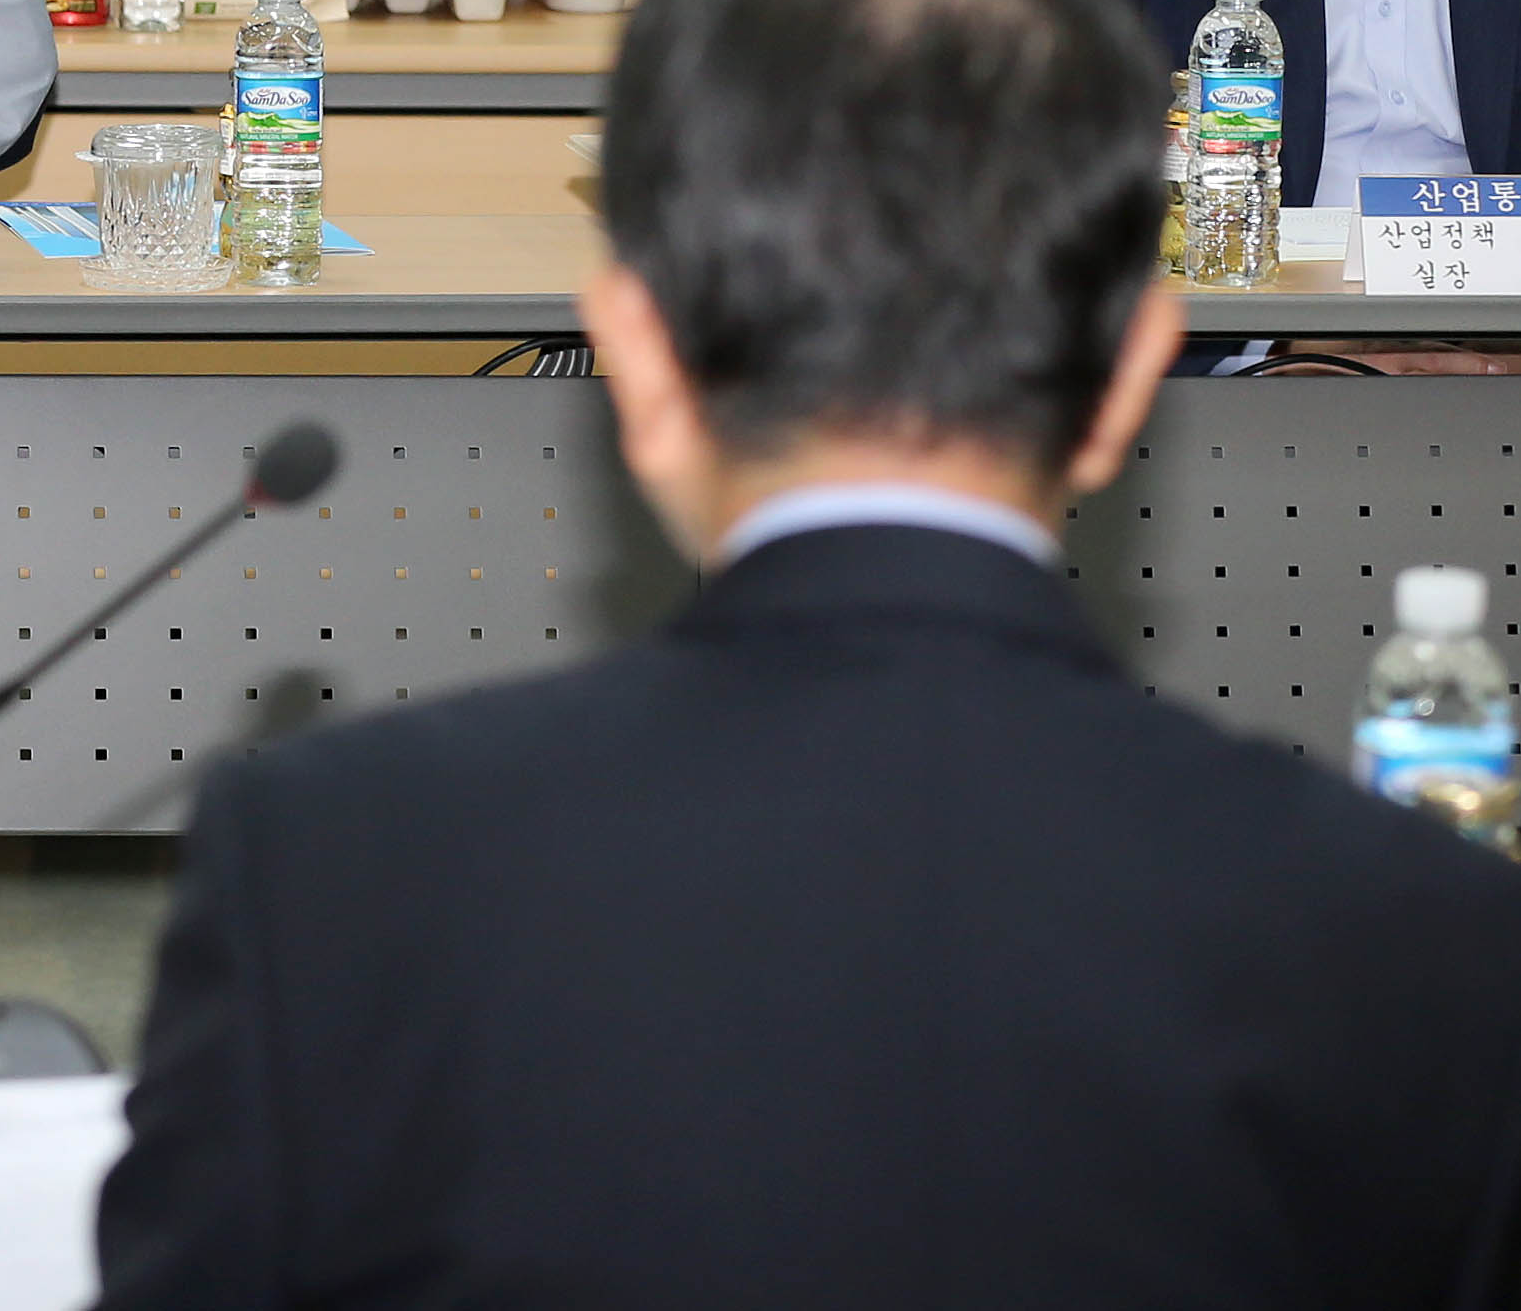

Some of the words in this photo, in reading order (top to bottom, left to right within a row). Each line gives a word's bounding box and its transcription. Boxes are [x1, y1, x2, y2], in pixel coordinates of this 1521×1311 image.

[245, 90, 309, 107] SamDaSoo
[1212, 89, 1273, 106] SamDaSoo
[1411, 179, 1521, 214] 산업통
[1377, 220, 1496, 251] 산업정책
[1413, 259, 1471, 290] 실장
